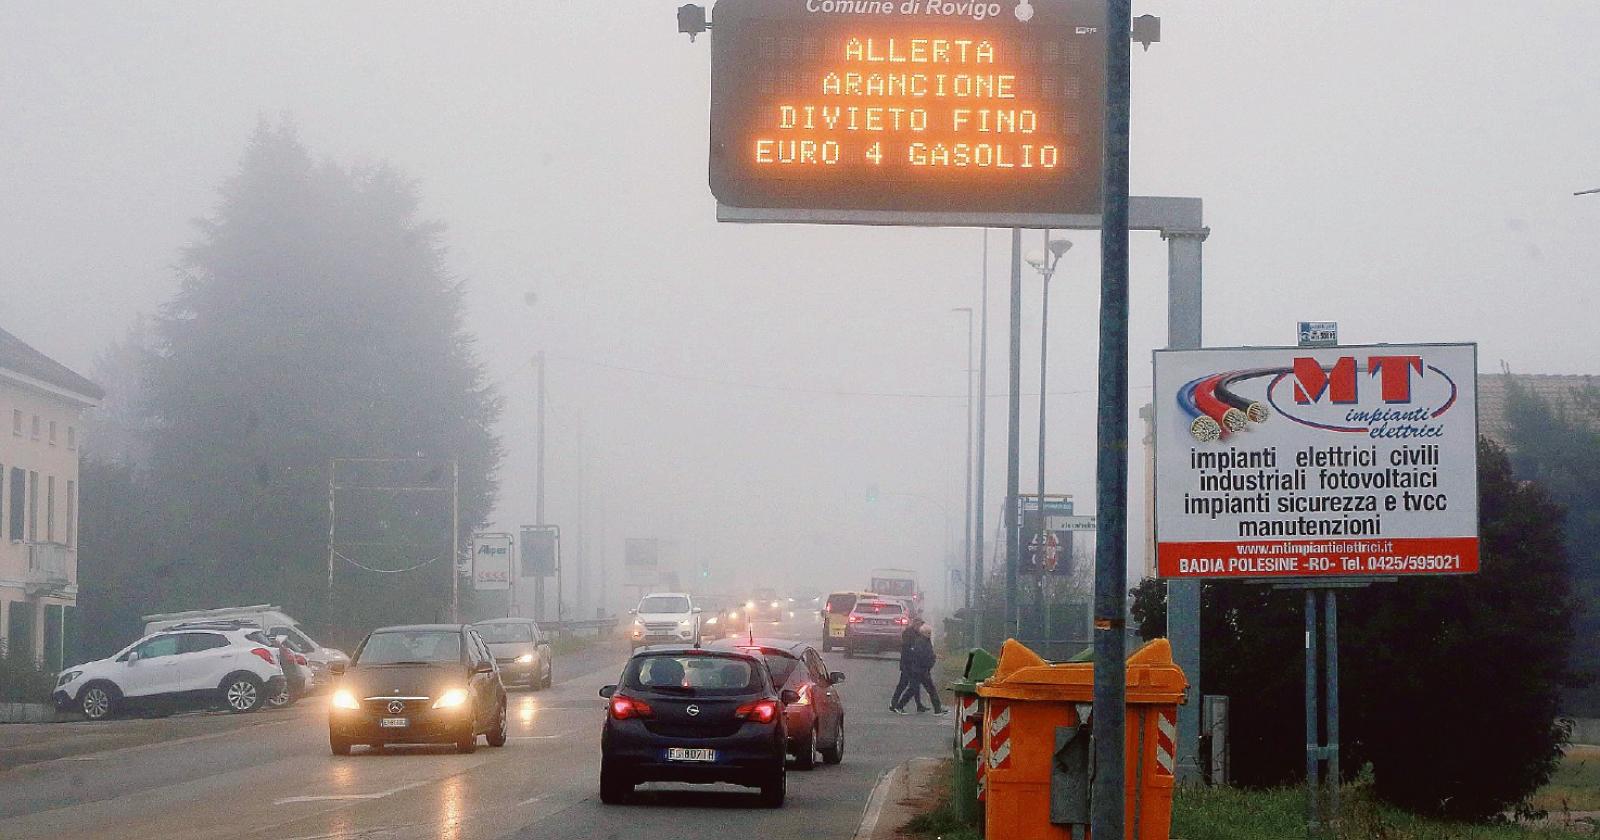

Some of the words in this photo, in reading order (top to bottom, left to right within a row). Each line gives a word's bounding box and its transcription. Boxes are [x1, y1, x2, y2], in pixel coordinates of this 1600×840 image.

[806, 0, 893, 14] Comune
[900, 0, 920, 15] di
[926, 0, 1001, 20] Rovigo
[845, 38, 995, 64] ALLERTA
[823, 72, 1016, 99] ARANCIONE
[779, 105, 928, 132] DIVIETO
[953, 109, 1038, 134] FINO
[756, 140, 840, 165] EURO
[866, 142, 883, 165] 4
[909, 142, 1059, 169] GASOLIO
[1293, 356, 1424, 405] MT
[1345, 407, 1430, 424] impianti
[1369, 424, 1444, 439] elettrici
[1191, 447, 1276, 471] impianti
[1296, 446, 1376, 466] elettrici
[1390, 445, 1439, 465] civili
[1200, 469, 1306, 491] industriali
[1319, 468, 1437, 489] fotovoltaici
[1184, 493, 1270, 519] impianti
[1277, 492, 1377, 512] sicurezza
[1384, 496, 1396, 511] e
[1403, 492, 1448, 511] tvcc
[1238, 514, 1381, 536] manutenzioni
[1237, 541, 1393, 554] www.mtimpiantielettrici.it
[1179, 558, 1224, 572] BADIA
[1229, 558, 1298, 571] POLESINE
[1303, 558, 1336, 571] -RO-
[1340, 558, 1365, 570] Tel.
[1367, 556, 1460, 570] 0425/595021
